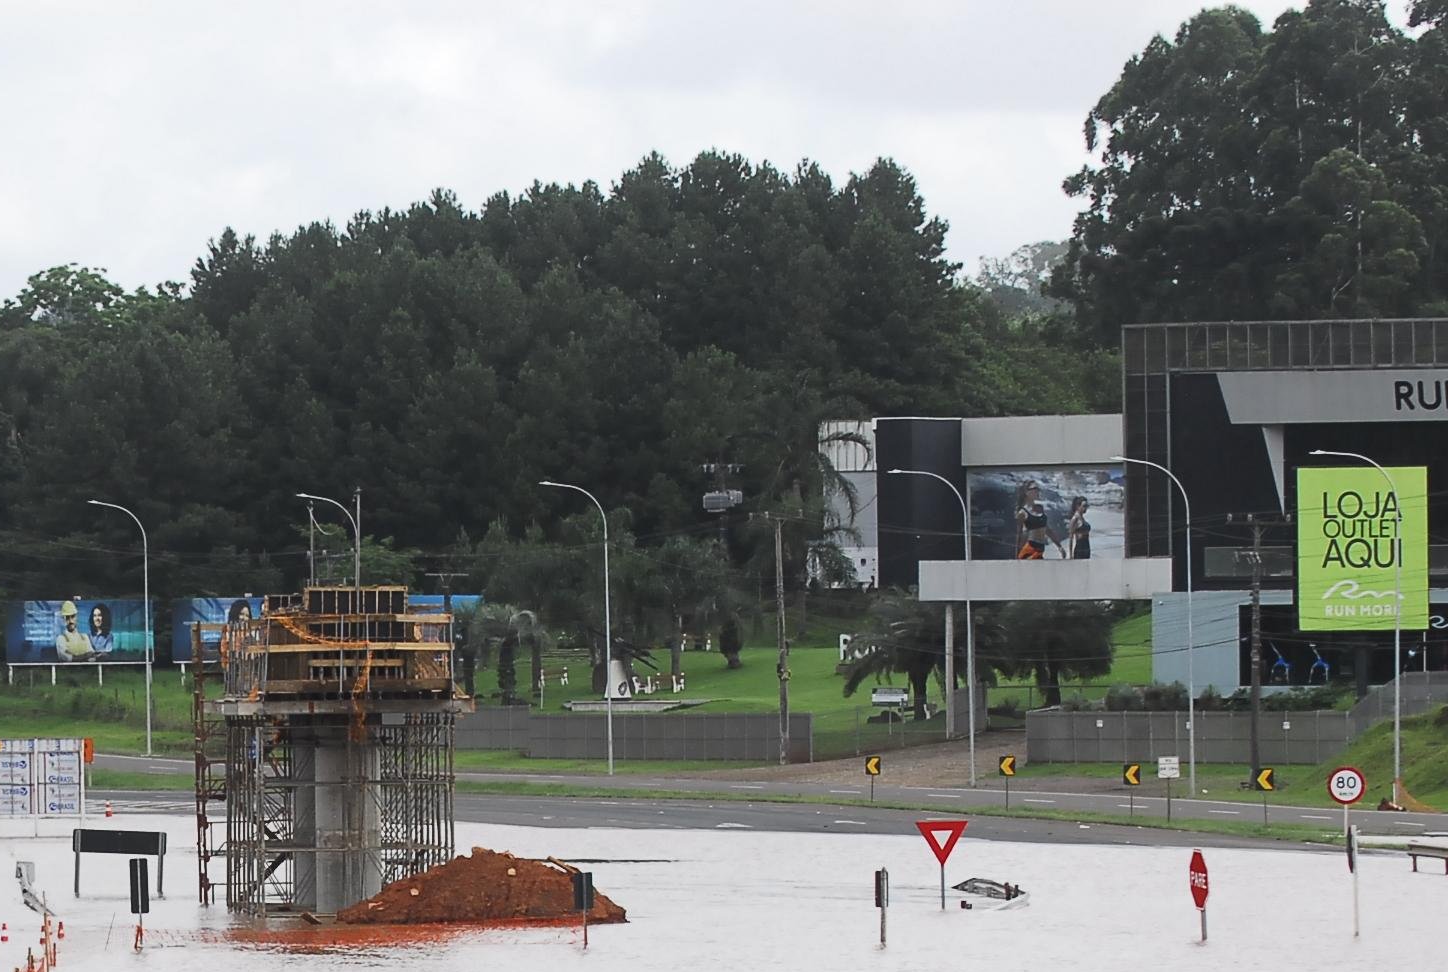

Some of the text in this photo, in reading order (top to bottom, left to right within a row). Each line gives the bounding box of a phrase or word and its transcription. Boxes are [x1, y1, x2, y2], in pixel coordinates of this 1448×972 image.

[1323, 491, 1402, 519] LOJA
[1323, 519, 1402, 538] OUTLET
[1322, 538, 1402, 568] AQUI
[1325, 605, 1356, 617] RUN
[1336, 776, 1357, 789] 80
